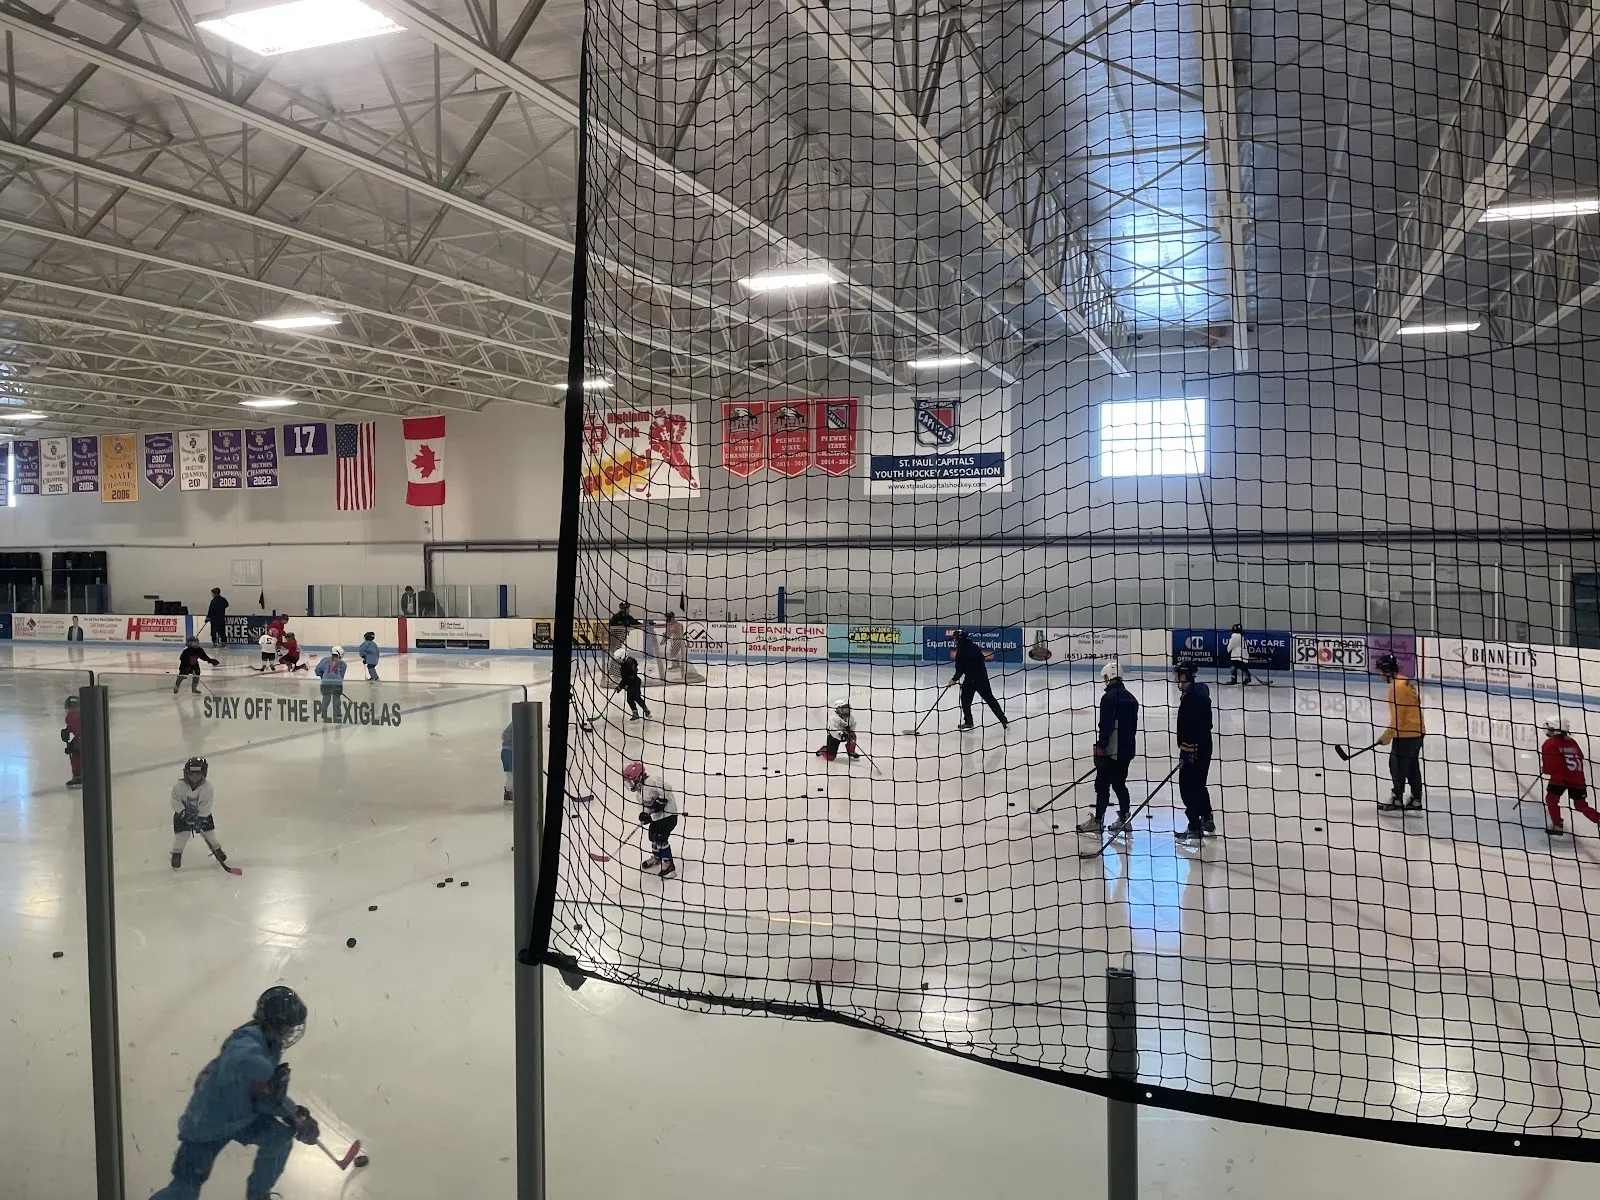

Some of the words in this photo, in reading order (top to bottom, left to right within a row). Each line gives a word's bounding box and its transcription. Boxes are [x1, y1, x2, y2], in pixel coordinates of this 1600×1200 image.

[918, 411, 952, 442] CAPITALS
[619, 427, 640, 438] Park
[294, 426, 316, 454] 17
[151, 455, 167, 463] 2007
[899, 459, 910, 467] ST.
[912, 458, 933, 467] PAUL
[936, 457, 974, 466] CAPITALS
[875, 470, 904, 478] YOUTH
[906, 469, 940, 478] HOCKEY
[943, 467, 1000, 476] ASSOCIATION
[219, 478, 236, 487] 2009
[253, 476, 272, 485] 2022
[49, 484, 63, 492] 2005
[79, 482, 94, 490] 2006
[112, 490, 130, 499] 2006
[225, 625, 248, 637] REE
[742, 626, 791, 634] LEEANN
[796, 627, 824, 635] CHIN
[849, 632, 867, 640] CAR
[870, 632, 900, 643] WASH
[687, 641, 723, 649] DITION
[927, 639, 946, 648] Expert
[985, 640, 1001, 650] wipe
[1002, 640, 1016, 649] outs
[1222, 639, 1258, 647] UNT
[1298, 638, 1319, 646] PLAY
[1333, 640, 1362, 648] AGAIN
[786, 646, 818, 654] Parkway
[1297, 647, 1364, 664] SPORTS
[1472, 648, 1537, 667] BENNETT'S
[203, 696, 240, 719] STAY
[244, 697, 272, 720] OFF
[277, 699, 310, 722] THE
[314, 701, 401, 726] PLEXIGLAS
